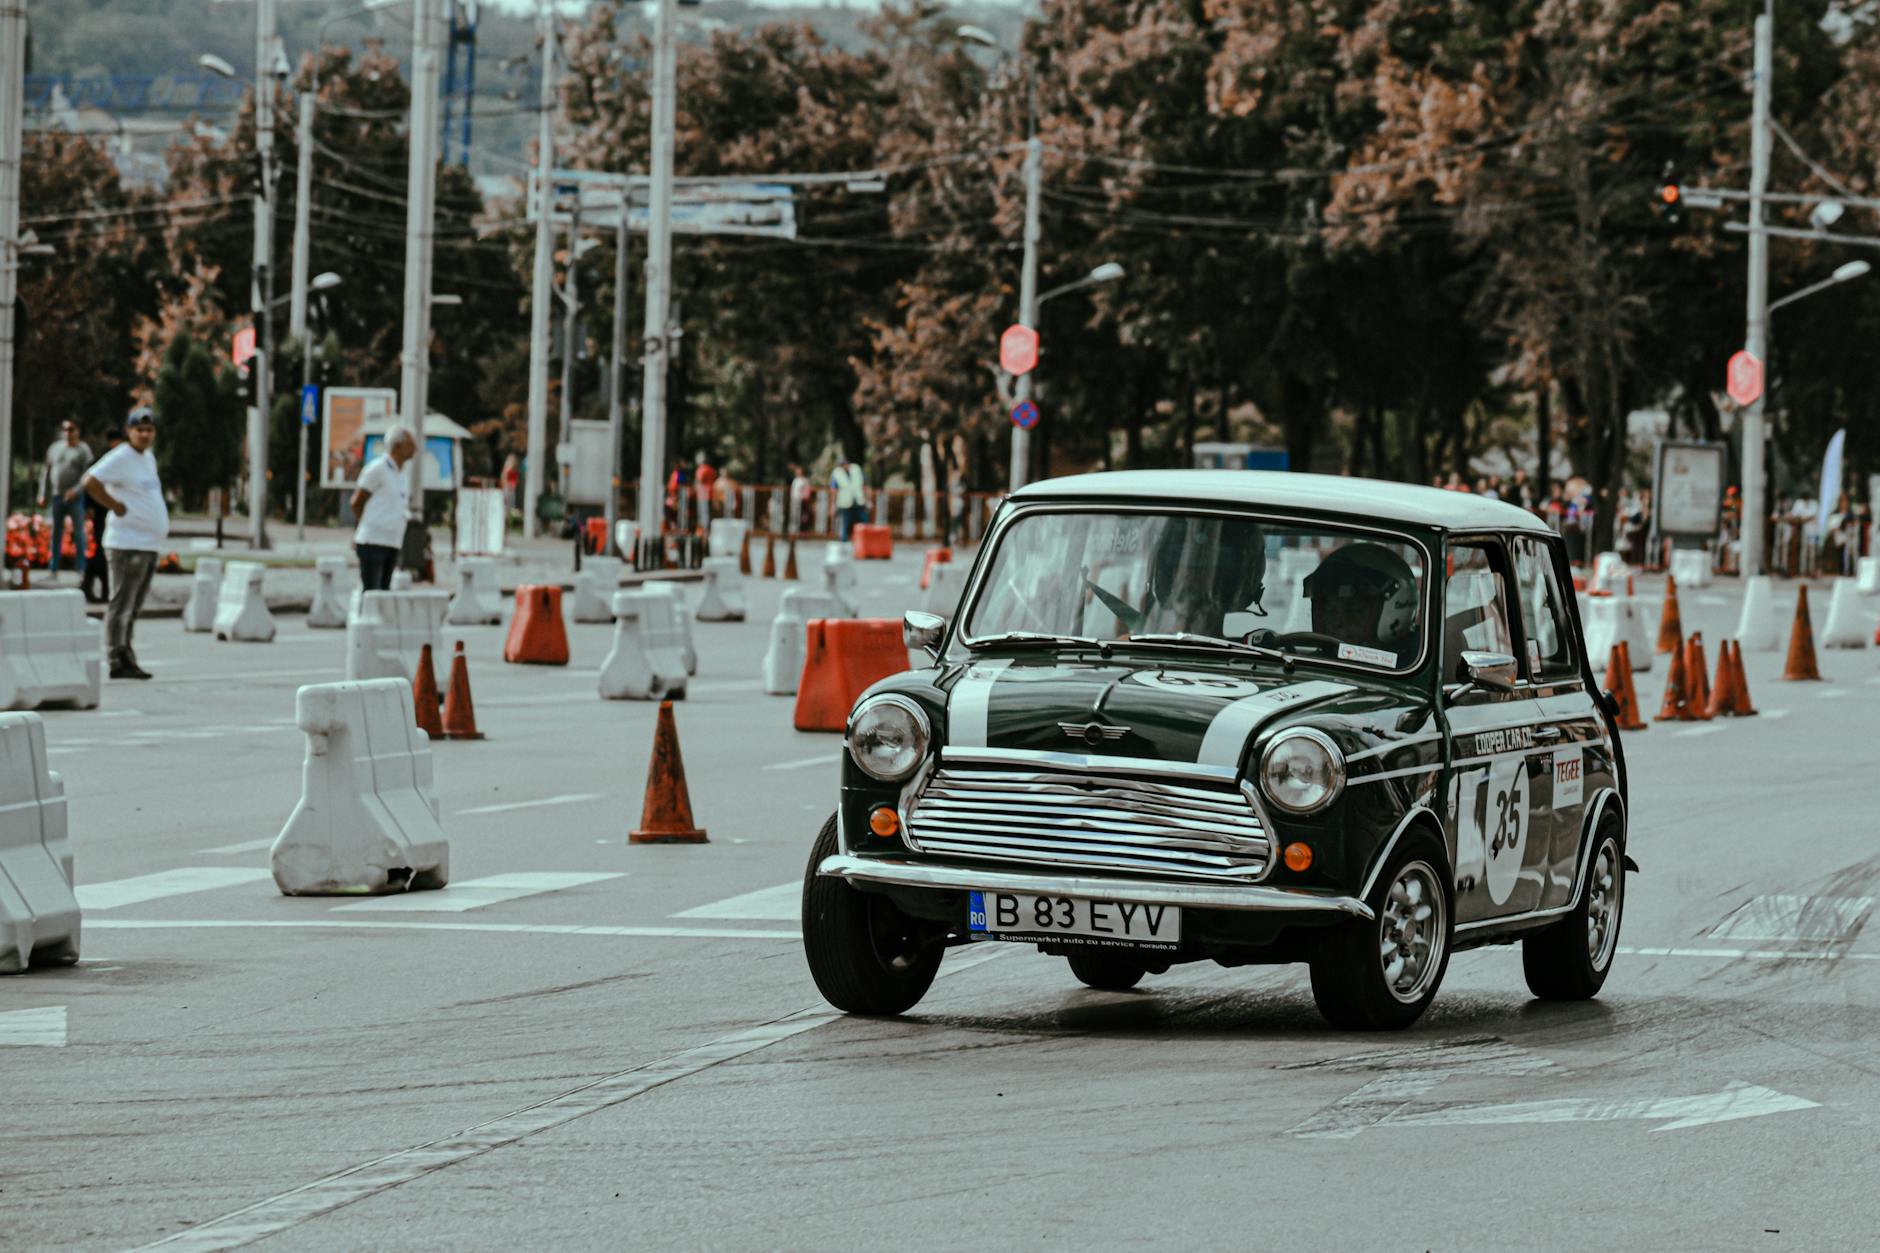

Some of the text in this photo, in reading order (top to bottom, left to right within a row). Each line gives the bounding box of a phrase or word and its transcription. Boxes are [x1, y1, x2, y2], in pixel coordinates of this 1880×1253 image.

[1474, 730, 1506, 755] COOPER
[1505, 727, 1521, 750] CAR
[1556, 759, 1580, 784] TEGEE
[1496, 790, 1521, 849] 35
[970, 912, 986, 925] RO
[996, 895, 1166, 936] B 83 EYV
[999, 933, 1061, 944] Supermarket
[1063, 937, 1085, 945] auto
[1086, 938, 1099, 946] cu
[1100, 939, 1135, 948] service
